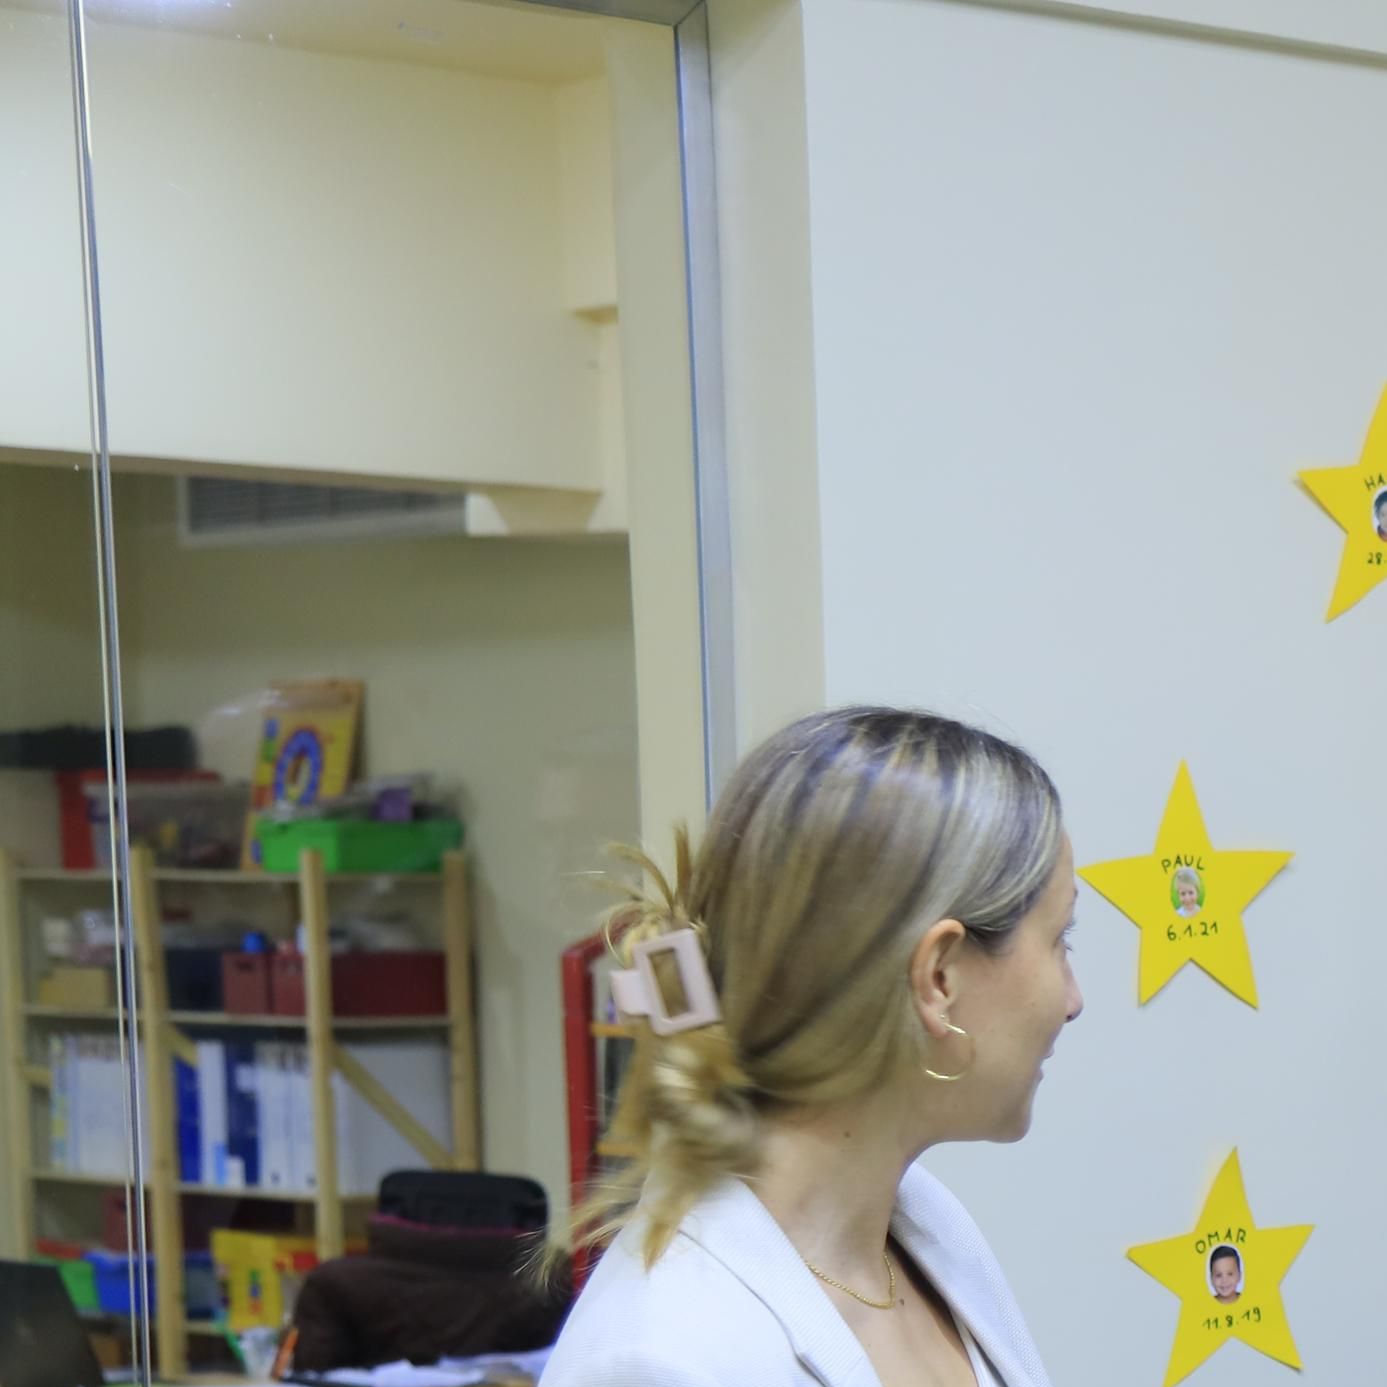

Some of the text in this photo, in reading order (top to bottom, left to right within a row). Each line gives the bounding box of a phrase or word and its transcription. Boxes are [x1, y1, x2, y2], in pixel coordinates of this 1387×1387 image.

[1160, 853, 1205, 875] PAUL
[1166, 920, 1219, 942] 6.1.21
[1194, 1227, 1247, 1254] OMAR
[1202, 1306, 1262, 1331] 11.8.19
